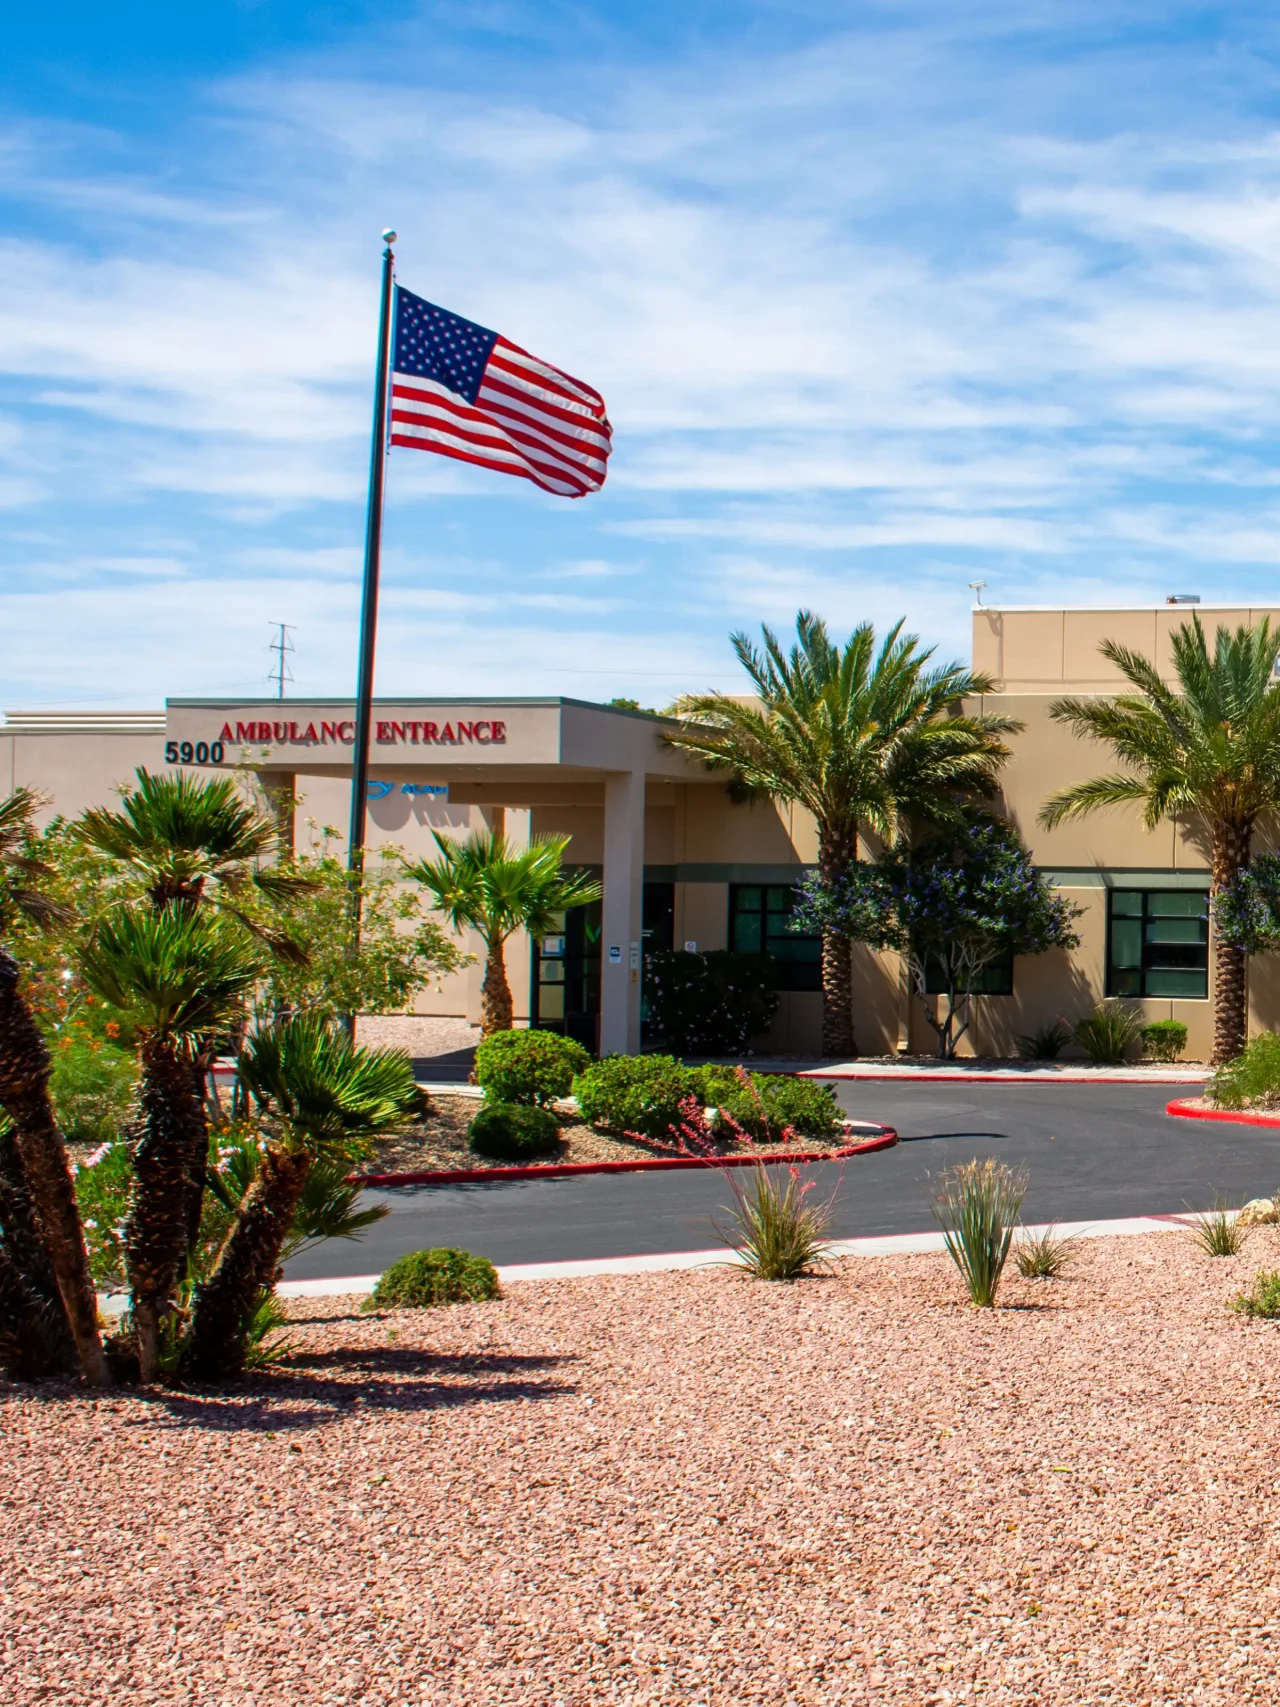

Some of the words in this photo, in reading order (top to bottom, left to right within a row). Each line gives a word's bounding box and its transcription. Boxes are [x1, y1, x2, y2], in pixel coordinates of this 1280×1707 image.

[219, 720, 357, 742] AMBULANC
[376, 720, 506, 742] ENTRANCE
[164, 741, 224, 764] 5900
